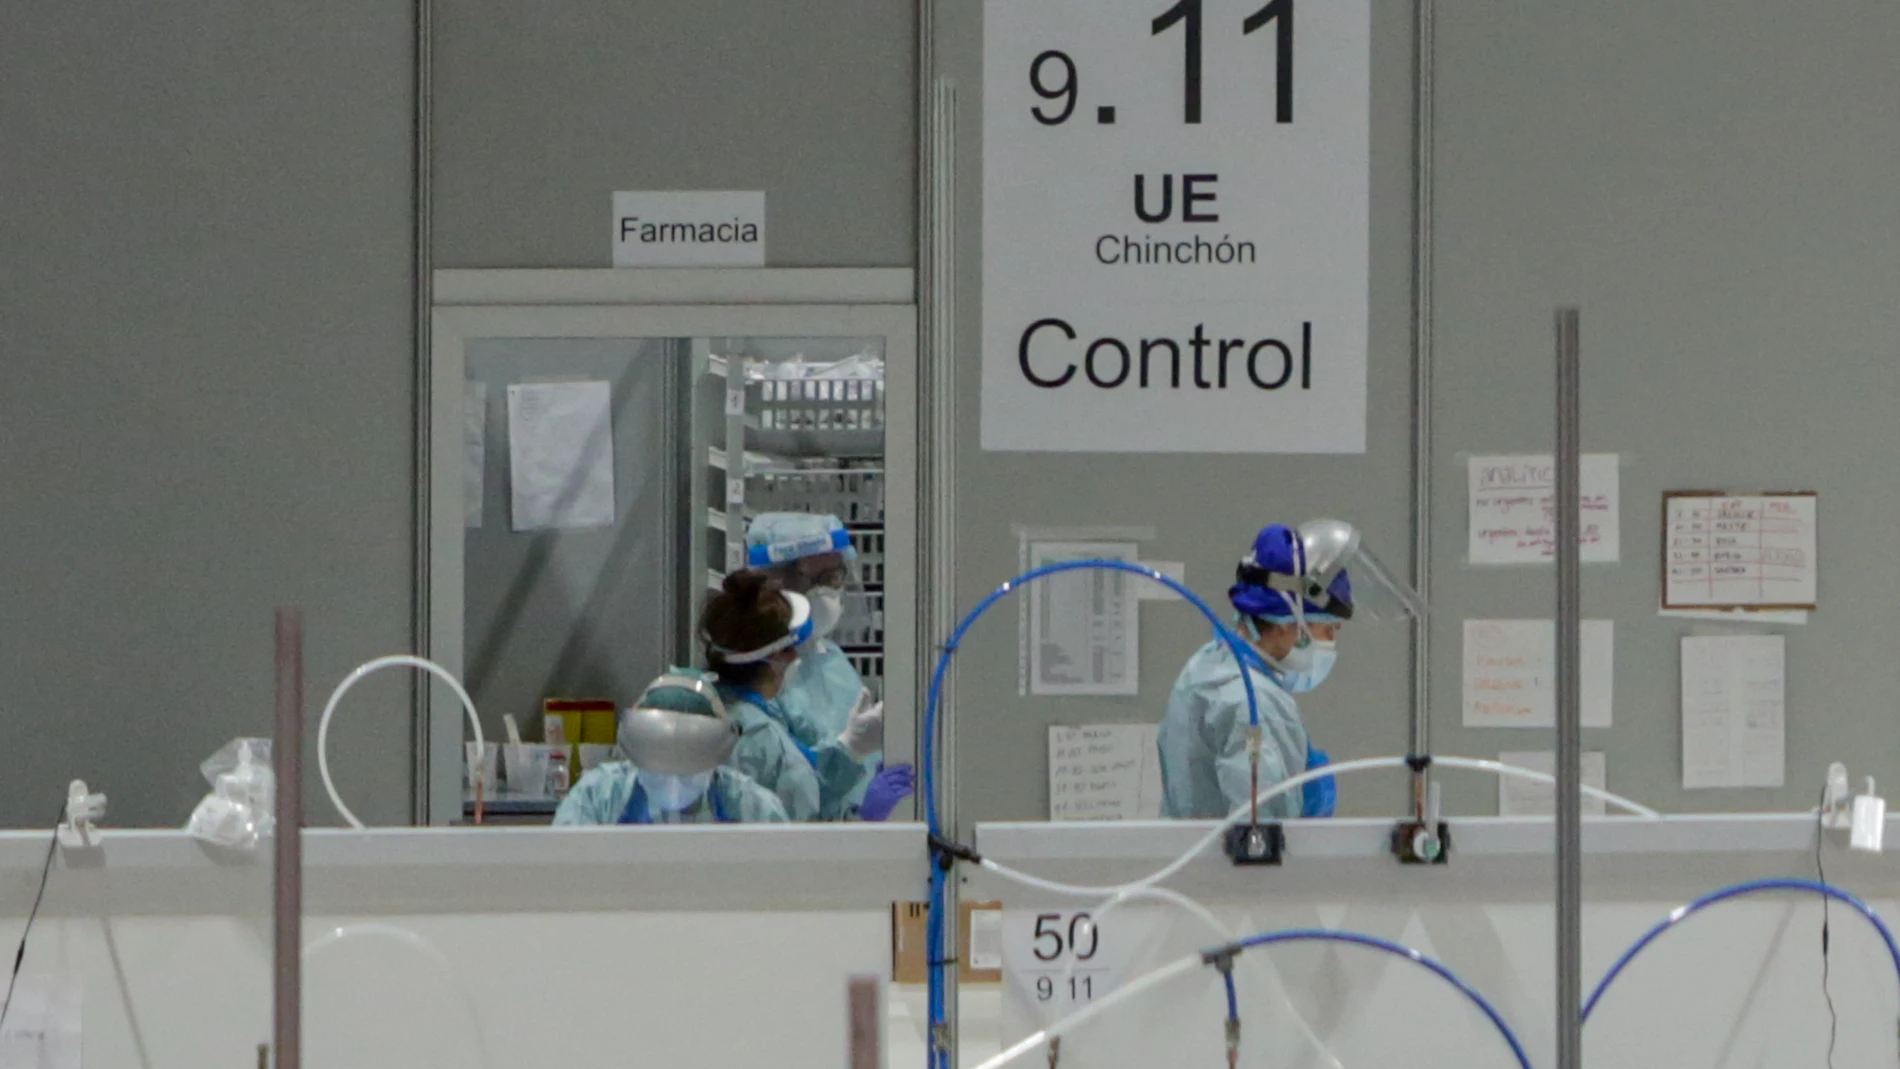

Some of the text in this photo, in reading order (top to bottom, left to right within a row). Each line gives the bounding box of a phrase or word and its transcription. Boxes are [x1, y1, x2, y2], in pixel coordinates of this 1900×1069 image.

[1134, 174, 1219, 223] UE
[620, 216, 758, 243] Farmacia
[1095, 234, 1256, 264] Chinchón
[1018, 318, 1311, 389] Control
[1033, 912, 1099, 961] 50
[1037, 975, 1092, 1001] 9 11
